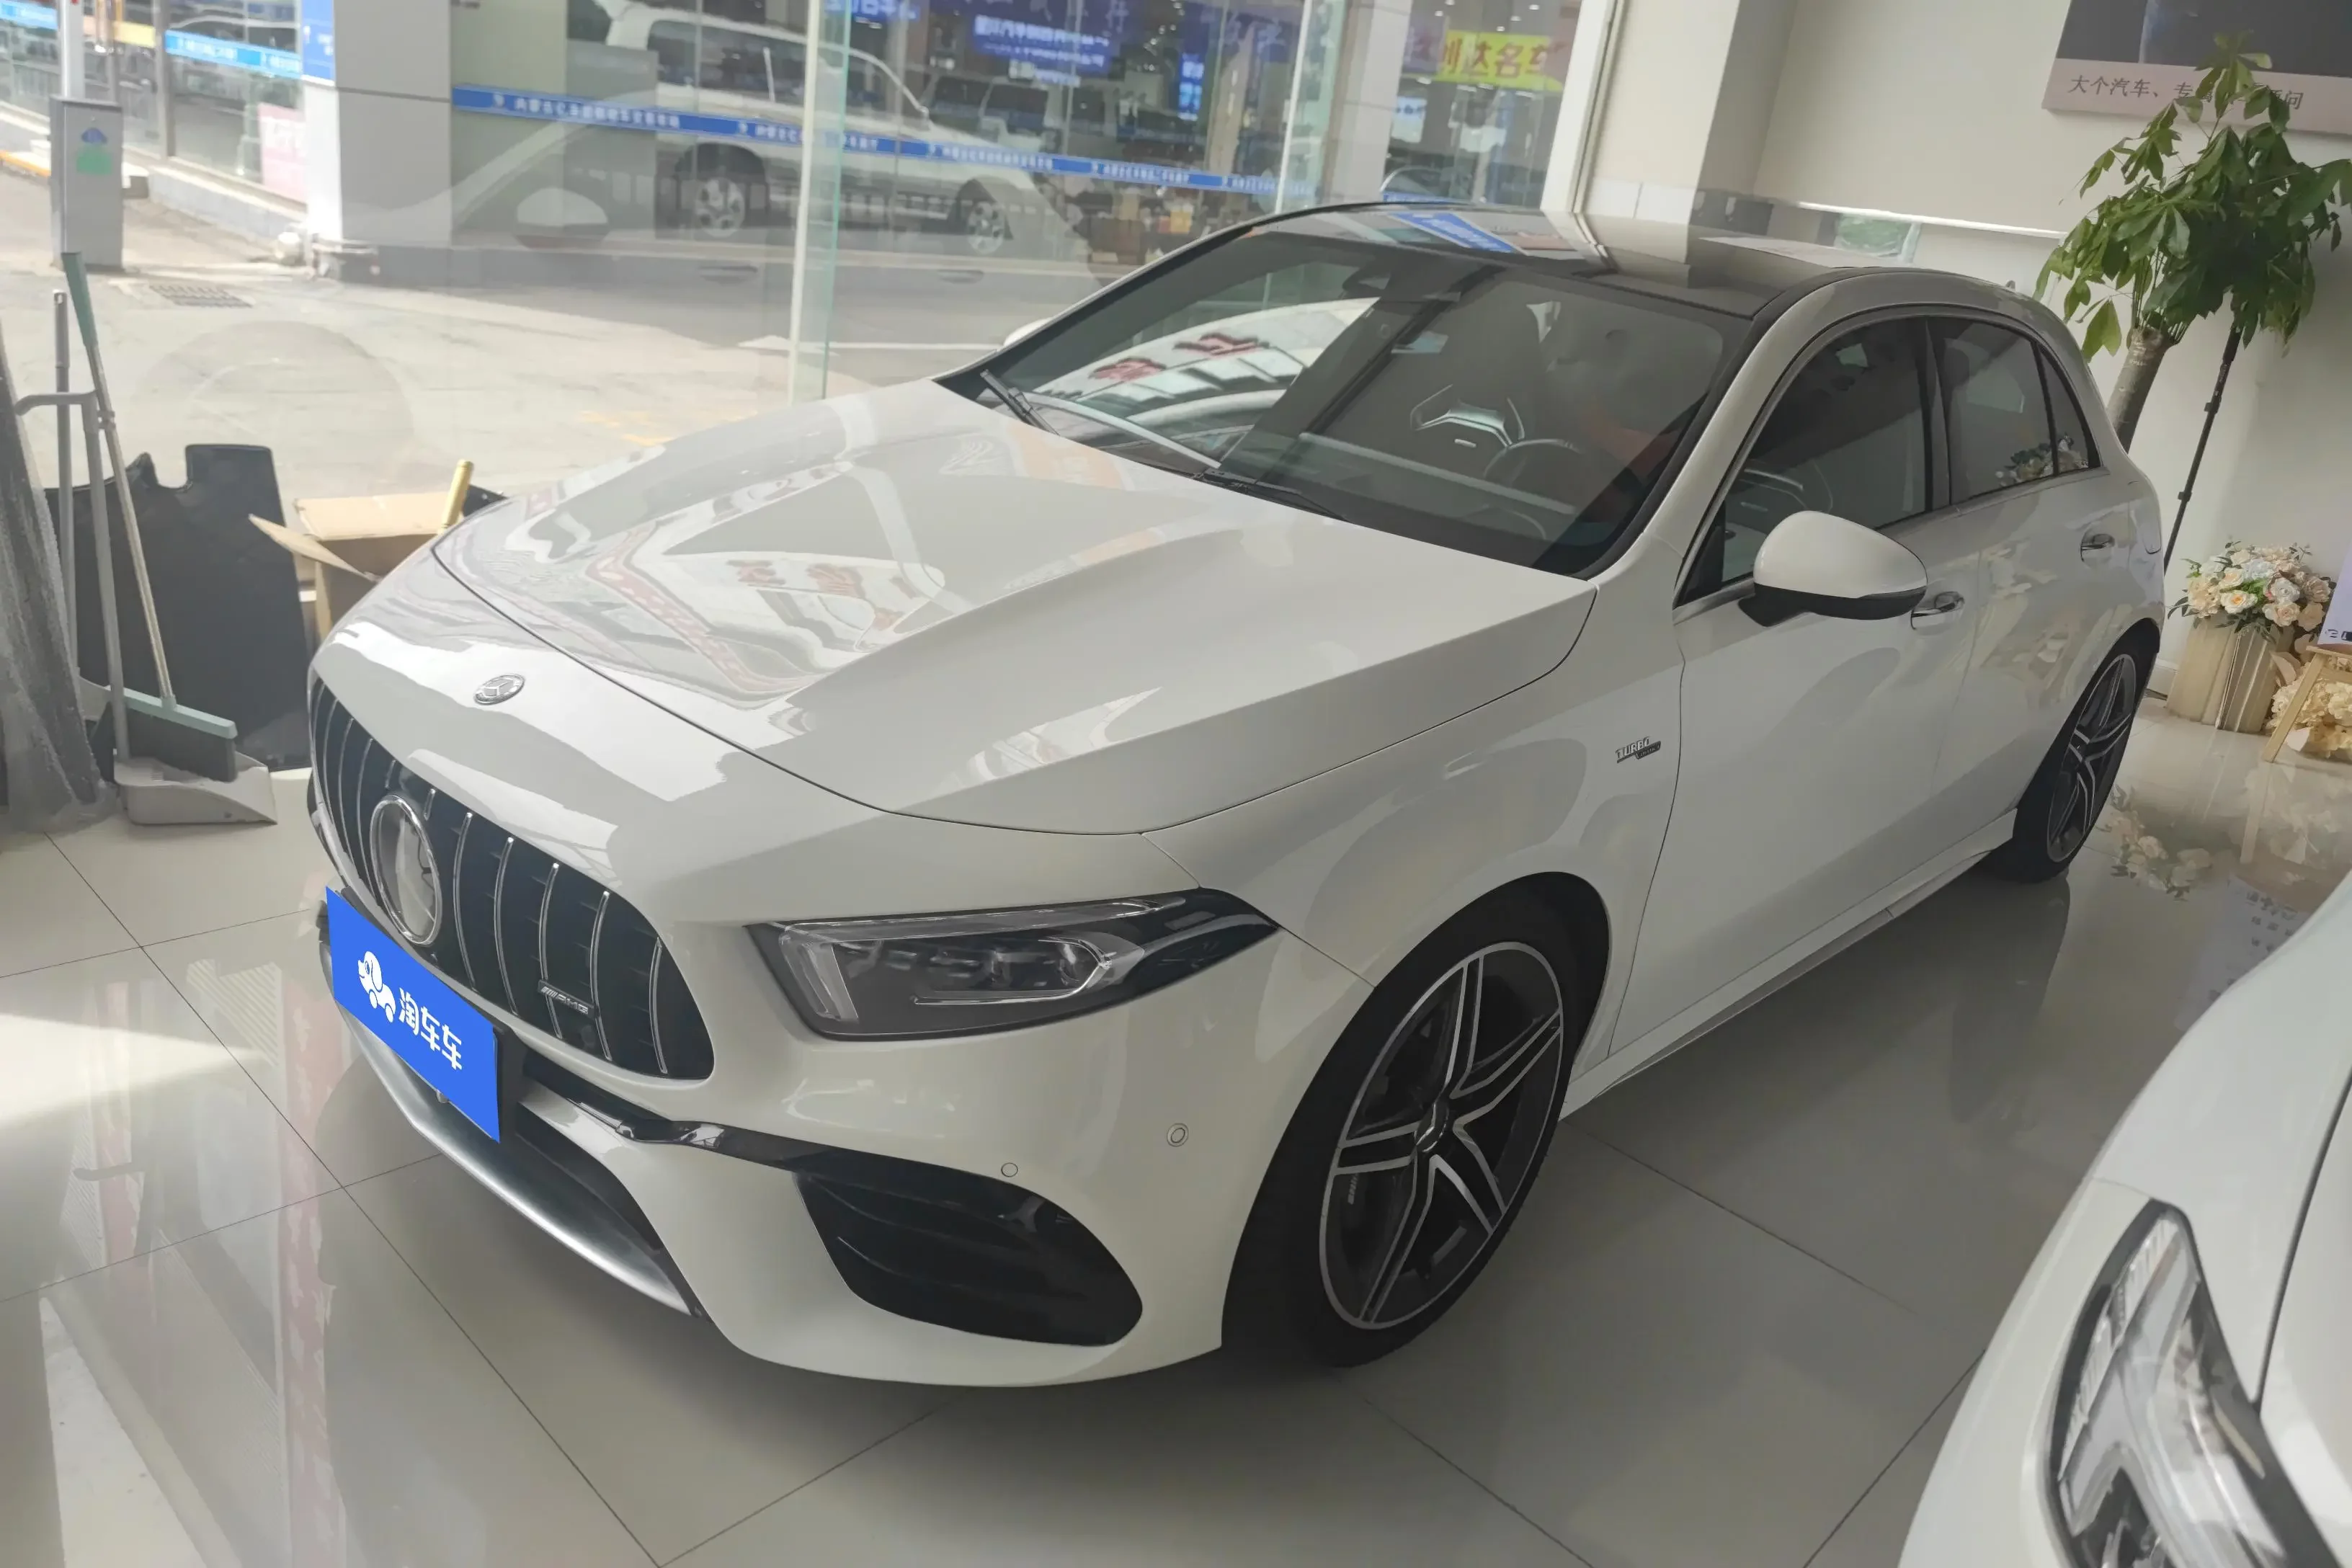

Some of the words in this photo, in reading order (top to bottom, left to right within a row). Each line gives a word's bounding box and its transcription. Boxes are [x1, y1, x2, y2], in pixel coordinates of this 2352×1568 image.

[2068, 75, 2304, 110] 大个汽车、专问
[1615, 736, 1650, 759] TURBO
